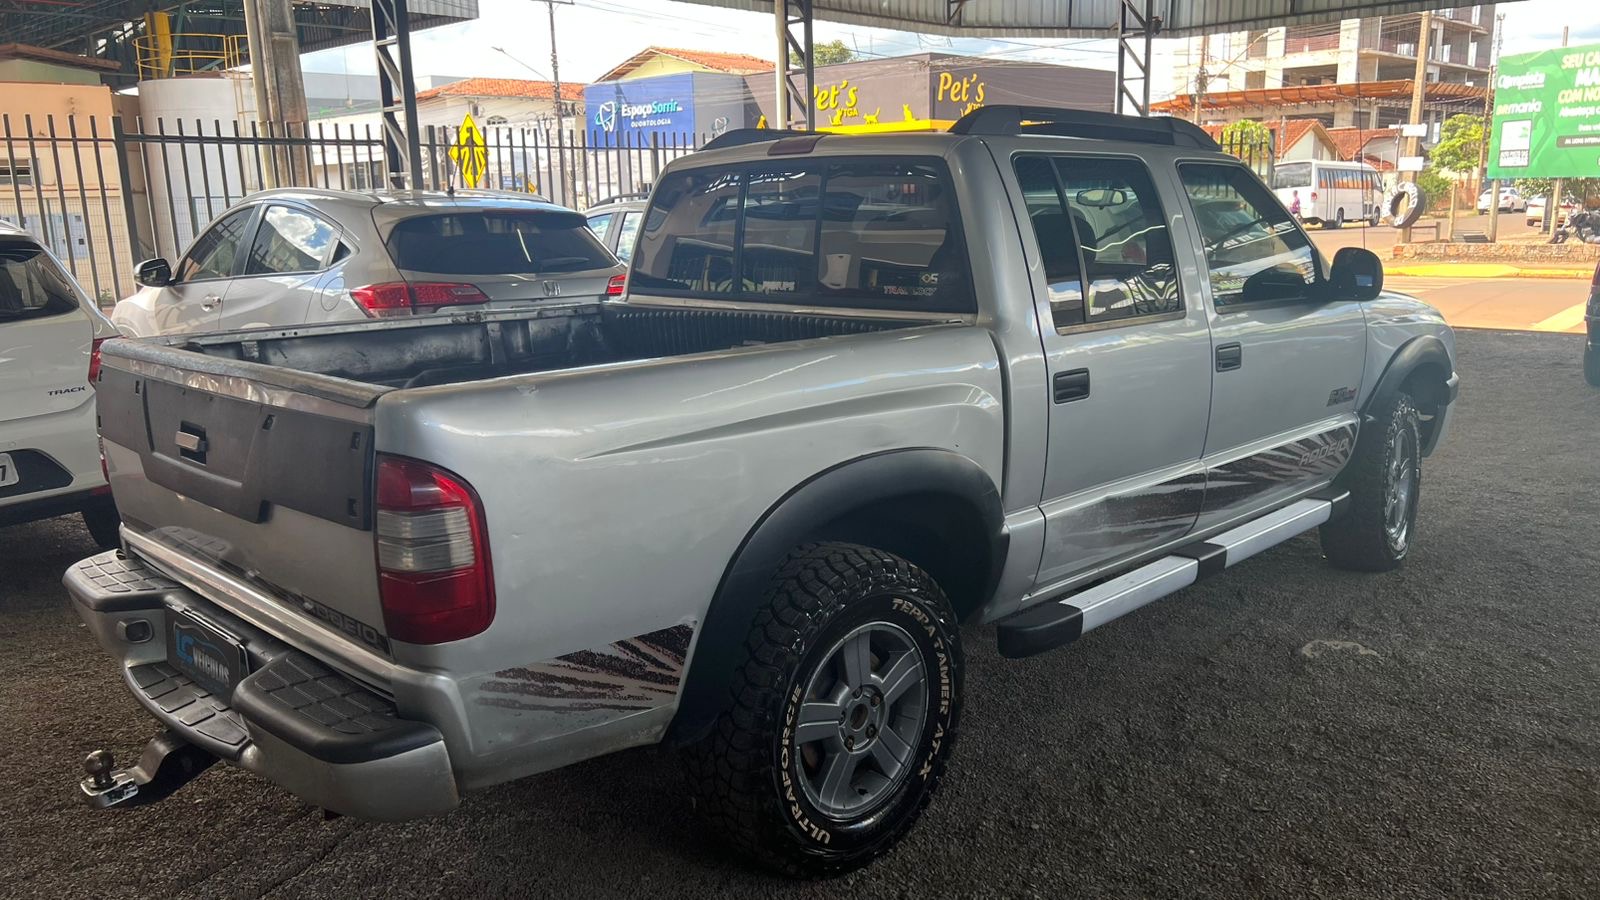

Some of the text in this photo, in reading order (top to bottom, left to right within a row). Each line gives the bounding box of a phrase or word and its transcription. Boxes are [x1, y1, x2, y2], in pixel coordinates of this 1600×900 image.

[1562, 54, 1584, 69] SEU
[938, 72, 985, 102] Pet's
[1559, 90, 1583, 104] COM
[631, 118, 671, 128] ODONTOLOGIA
[48, 386, 85, 396] TRACK
[892, 598, 936, 637] TERRA
[934, 640, 951, 715] TAMER
[781, 684, 831, 846] ULTRAFORCE
